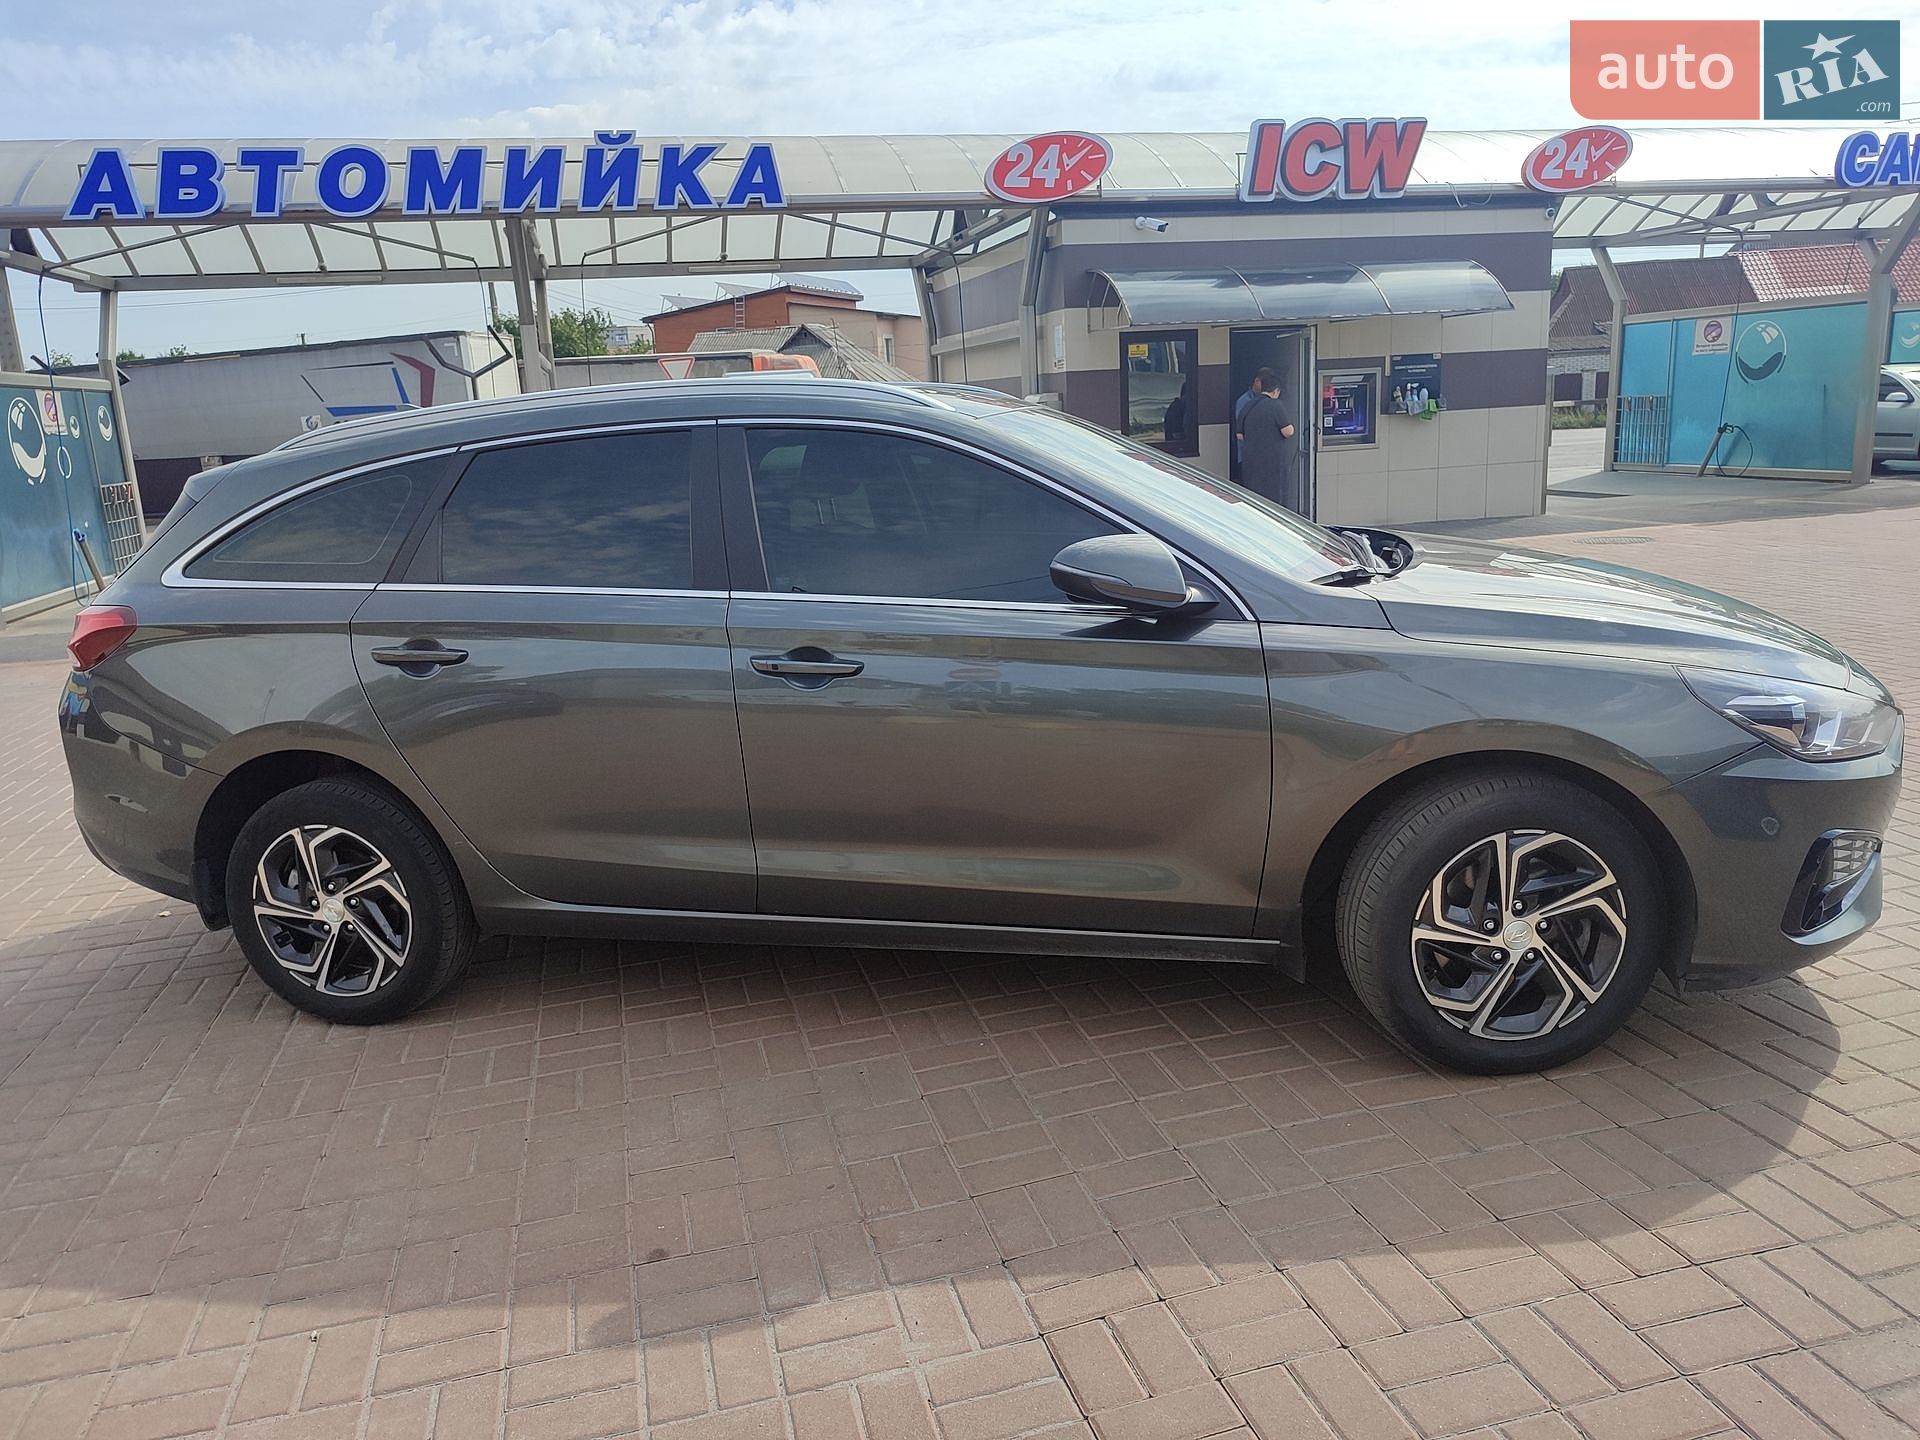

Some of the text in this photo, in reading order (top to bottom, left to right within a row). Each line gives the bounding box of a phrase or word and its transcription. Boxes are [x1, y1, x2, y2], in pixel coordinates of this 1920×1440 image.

[64, 130, 788, 220] АВТОМИЙКА
[1004, 143, 1061, 188] 24
[1243, 118, 1428, 200] ICW
[1541, 139, 1590, 180] 24
[1836, 131, 1920, 187] CA
